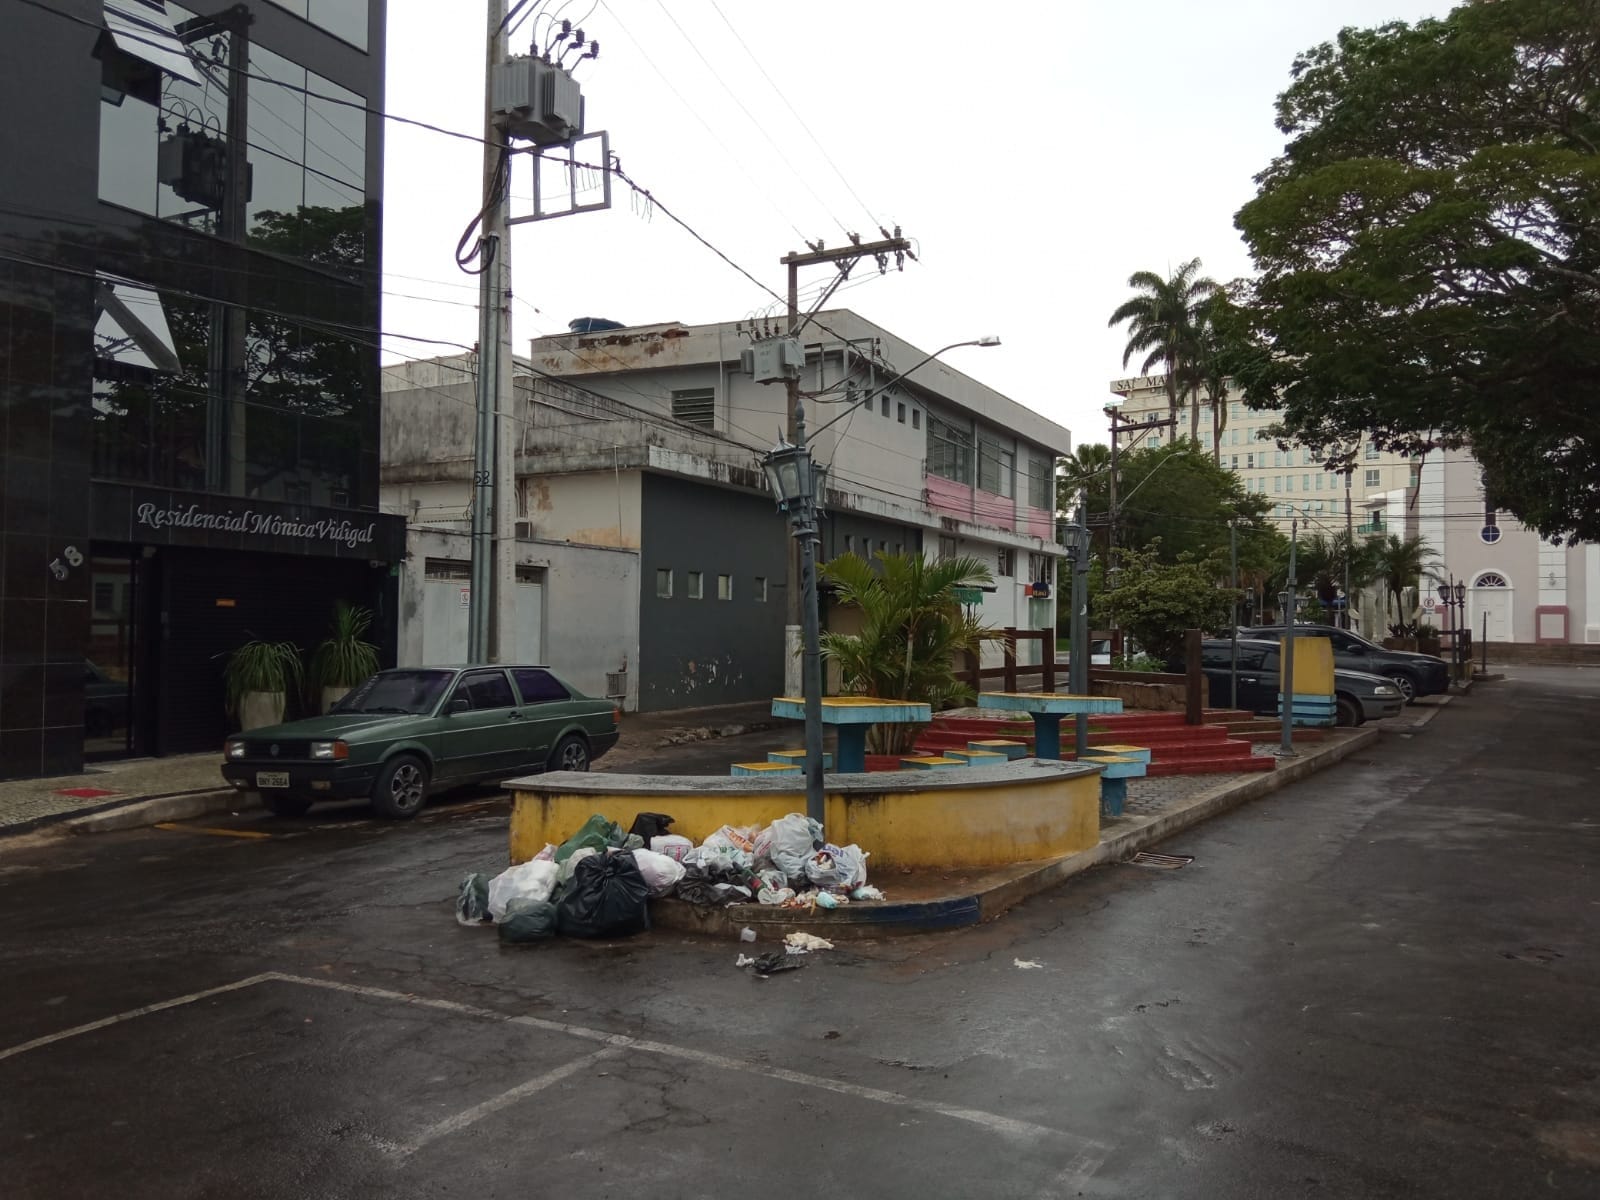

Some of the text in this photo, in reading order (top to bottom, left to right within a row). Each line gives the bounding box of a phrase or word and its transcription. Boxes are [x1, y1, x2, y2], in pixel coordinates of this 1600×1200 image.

[137, 502, 375, 548] Residencial Mônica Vidigal
[49, 545, 83, 580] 58
